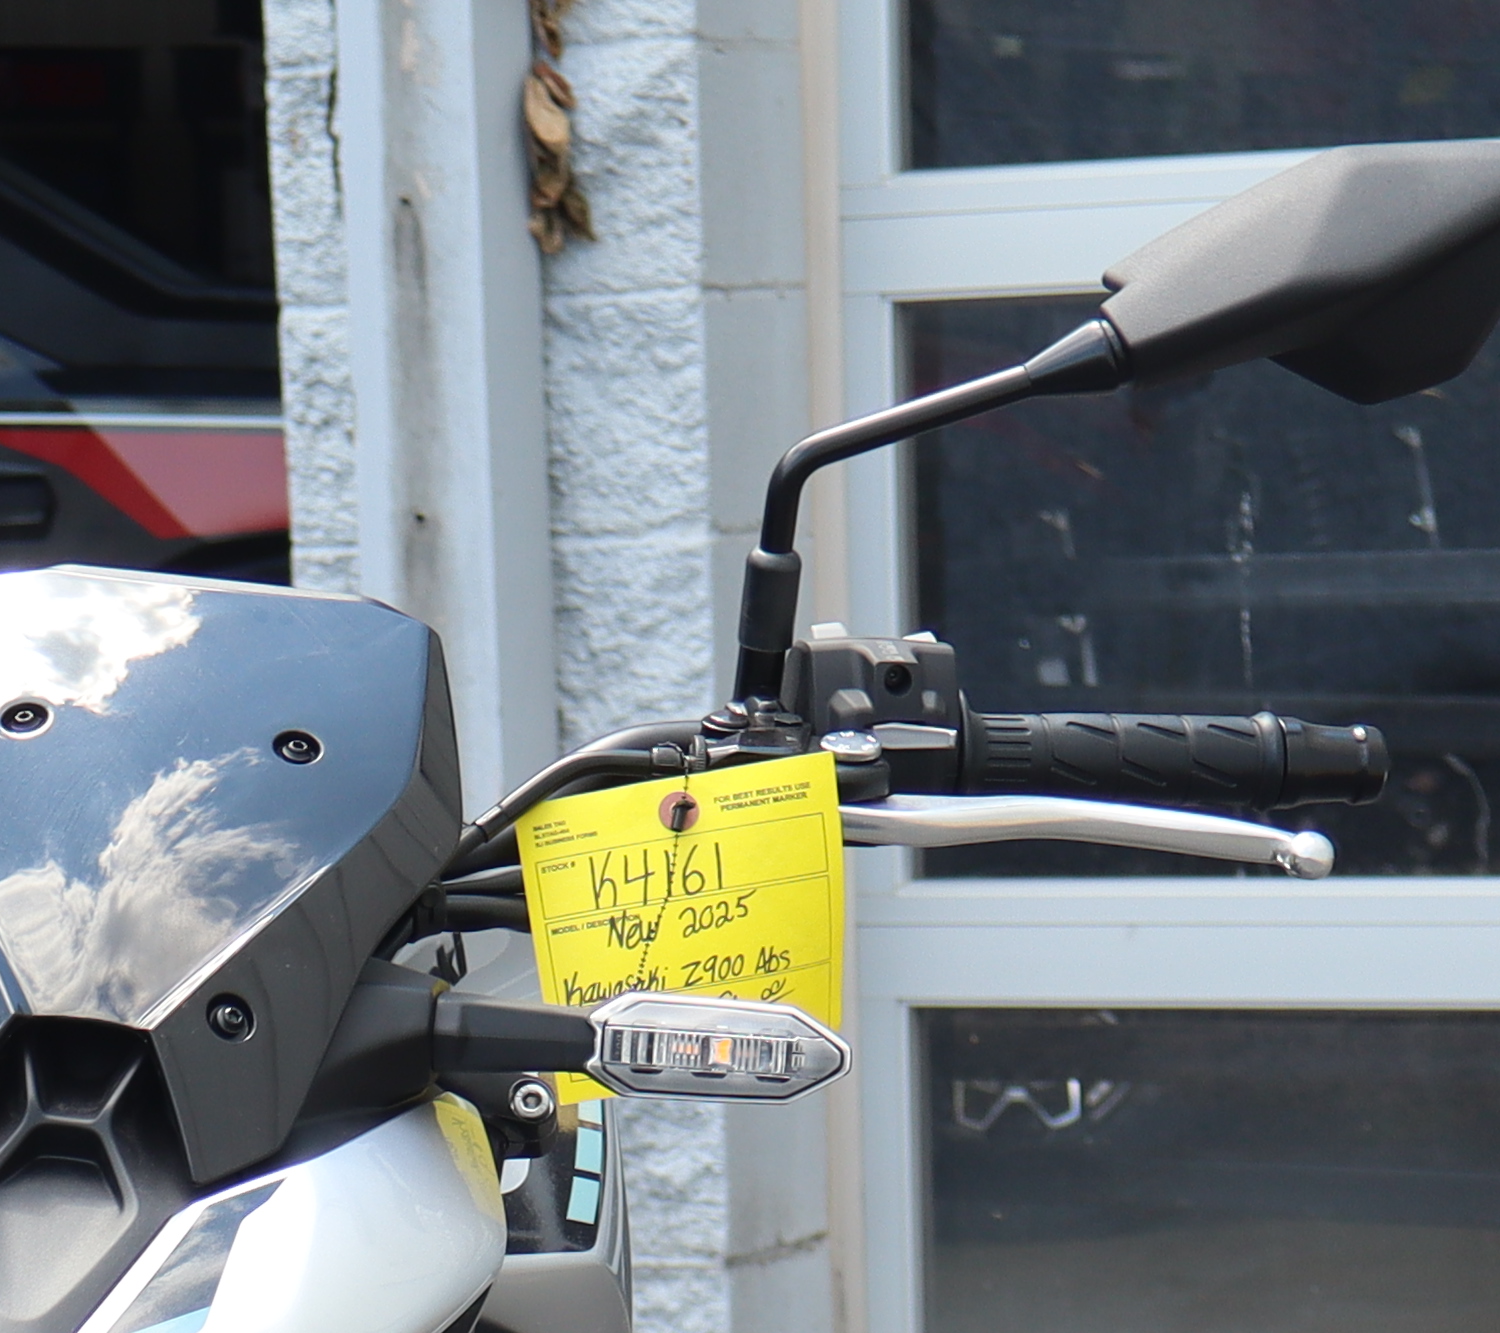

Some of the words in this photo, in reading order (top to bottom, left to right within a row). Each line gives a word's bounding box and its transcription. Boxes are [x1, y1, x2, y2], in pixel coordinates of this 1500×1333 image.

[713, 794, 731, 804] FOR
[732, 790, 754, 801] BEST
[756, 784, 794, 797] RESULTS
[794, 781, 811, 790] USE
[720, 797, 771, 812] PERMANENT
[772, 791, 808, 803] MARKER
[541, 862, 570, 874] STOCK
[588, 841, 725, 911] K4161
[678, 889, 758, 939] 2025
[551, 924, 580, 936] MODEL
